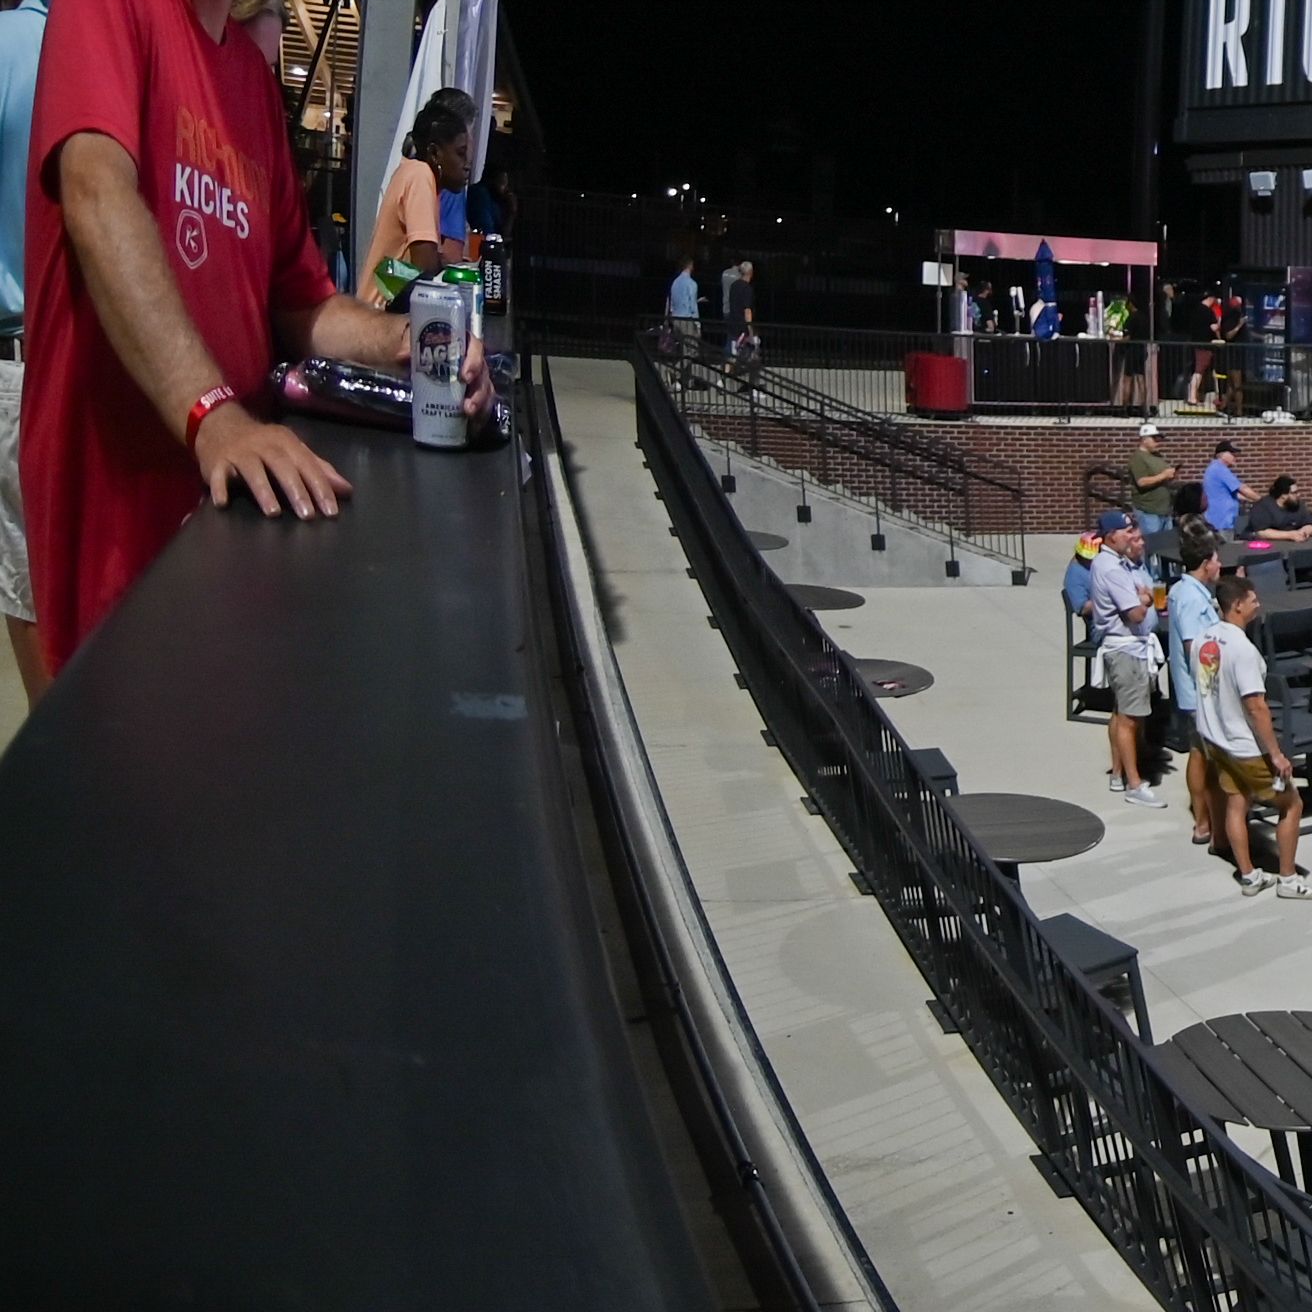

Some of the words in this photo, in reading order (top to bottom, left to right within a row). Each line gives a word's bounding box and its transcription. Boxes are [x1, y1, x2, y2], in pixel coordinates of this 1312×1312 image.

[484, 260, 493, 299] FALCON
[493, 264, 502, 299] SMASH
[200, 387, 227, 410] SUITE
